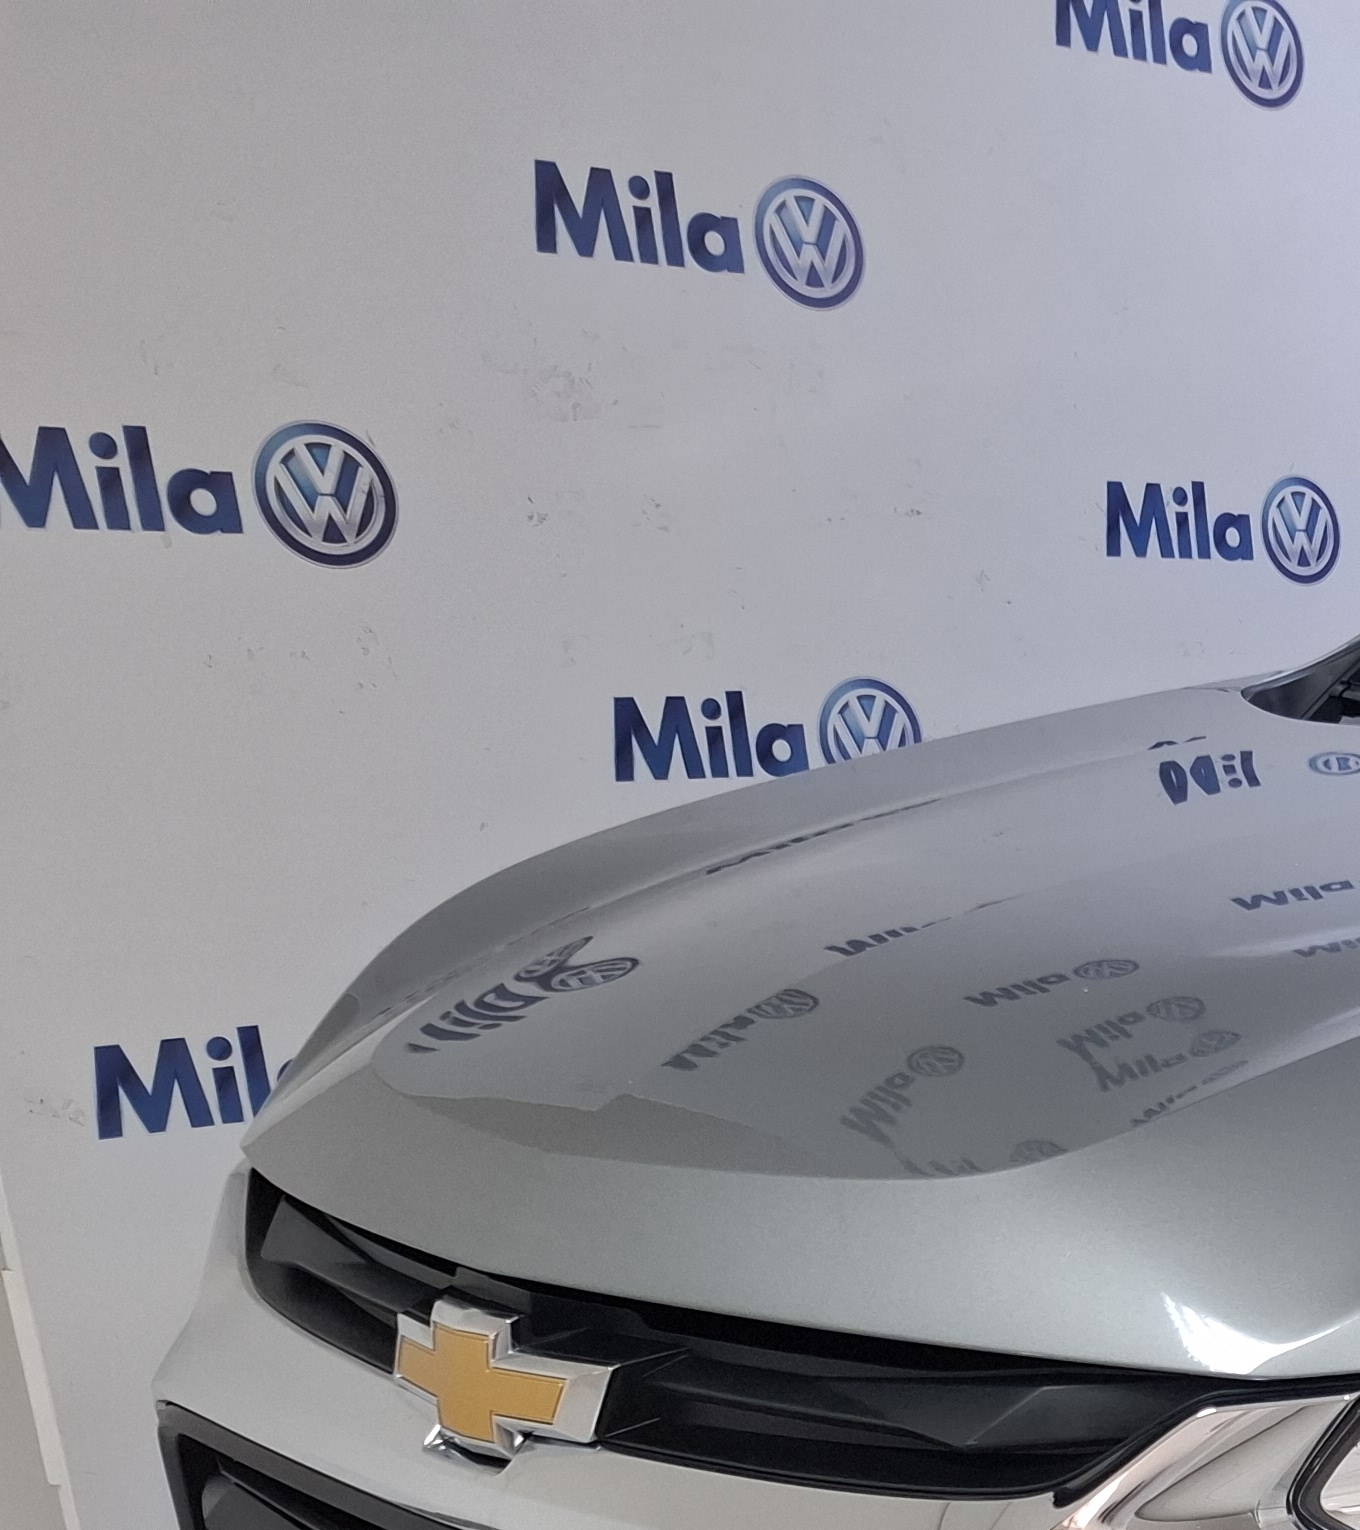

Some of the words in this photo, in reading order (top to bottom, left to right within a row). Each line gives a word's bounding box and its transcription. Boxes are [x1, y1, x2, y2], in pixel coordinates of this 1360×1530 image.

[1055, 0, 1212, 73] Mila
[534, 159, 744, 273] Mila
[0, 425, 243, 534] Mila
[1106, 481, 1254, 561] Mila
[614, 691, 809, 782] Mila
[94, 1025, 294, 1140] Mil
